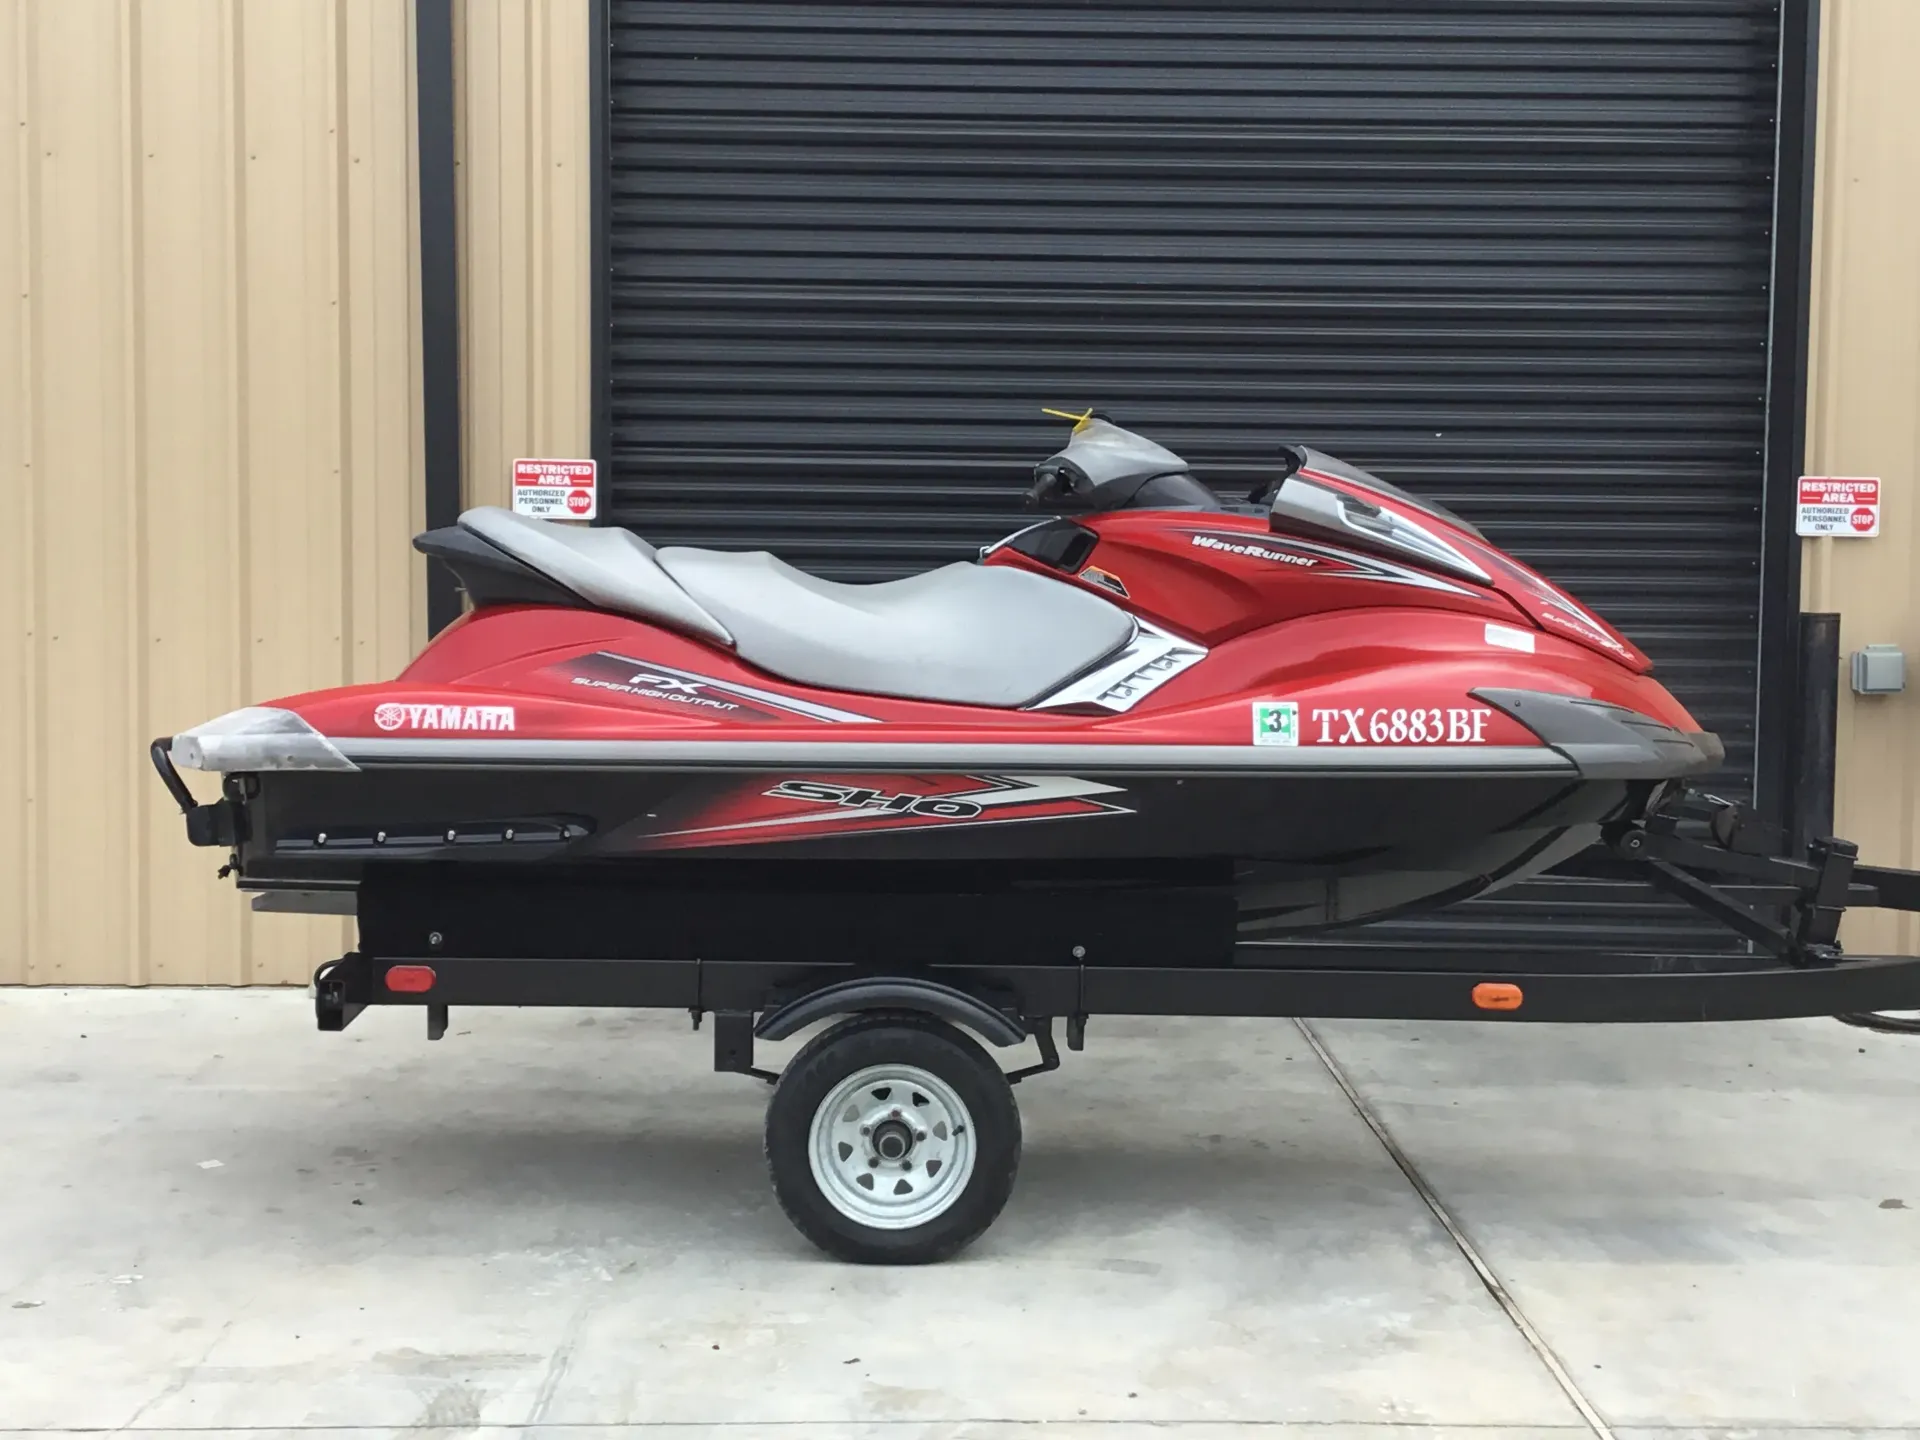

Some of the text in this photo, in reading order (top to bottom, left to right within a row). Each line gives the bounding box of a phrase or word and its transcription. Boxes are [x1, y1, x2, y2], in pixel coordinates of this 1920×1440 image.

[517, 463, 592, 476] RESTRICTED
[537, 475, 572, 485] AREA
[1802, 481, 1876, 493] RESTRICTED
[517, 489, 566, 497] AUTHORIZED
[1821, 493, 1856, 503] AREA
[518, 497, 564, 505] PERSONNEL
[568, 496, 590, 507] STOP
[531, 505, 551, 513] ONLY
[1801, 506, 1849, 515] AUTHORIZED
[1802, 515, 1847, 523] PERSONNEL
[1852, 514, 1874, 525] STOP
[1814, 523, 1834, 531] ONLY
[1192, 535, 1318, 567] WaveRunner
[628, 673, 707, 695] FX
[570, 676, 739, 711] SUPER HIGH OUTPUT
[408, 704, 516, 731] YAMAHA
[1268, 709, 1282, 733] 3
[1312, 707, 1492, 744] TX6883BF
[760, 779, 983, 820] SHO
